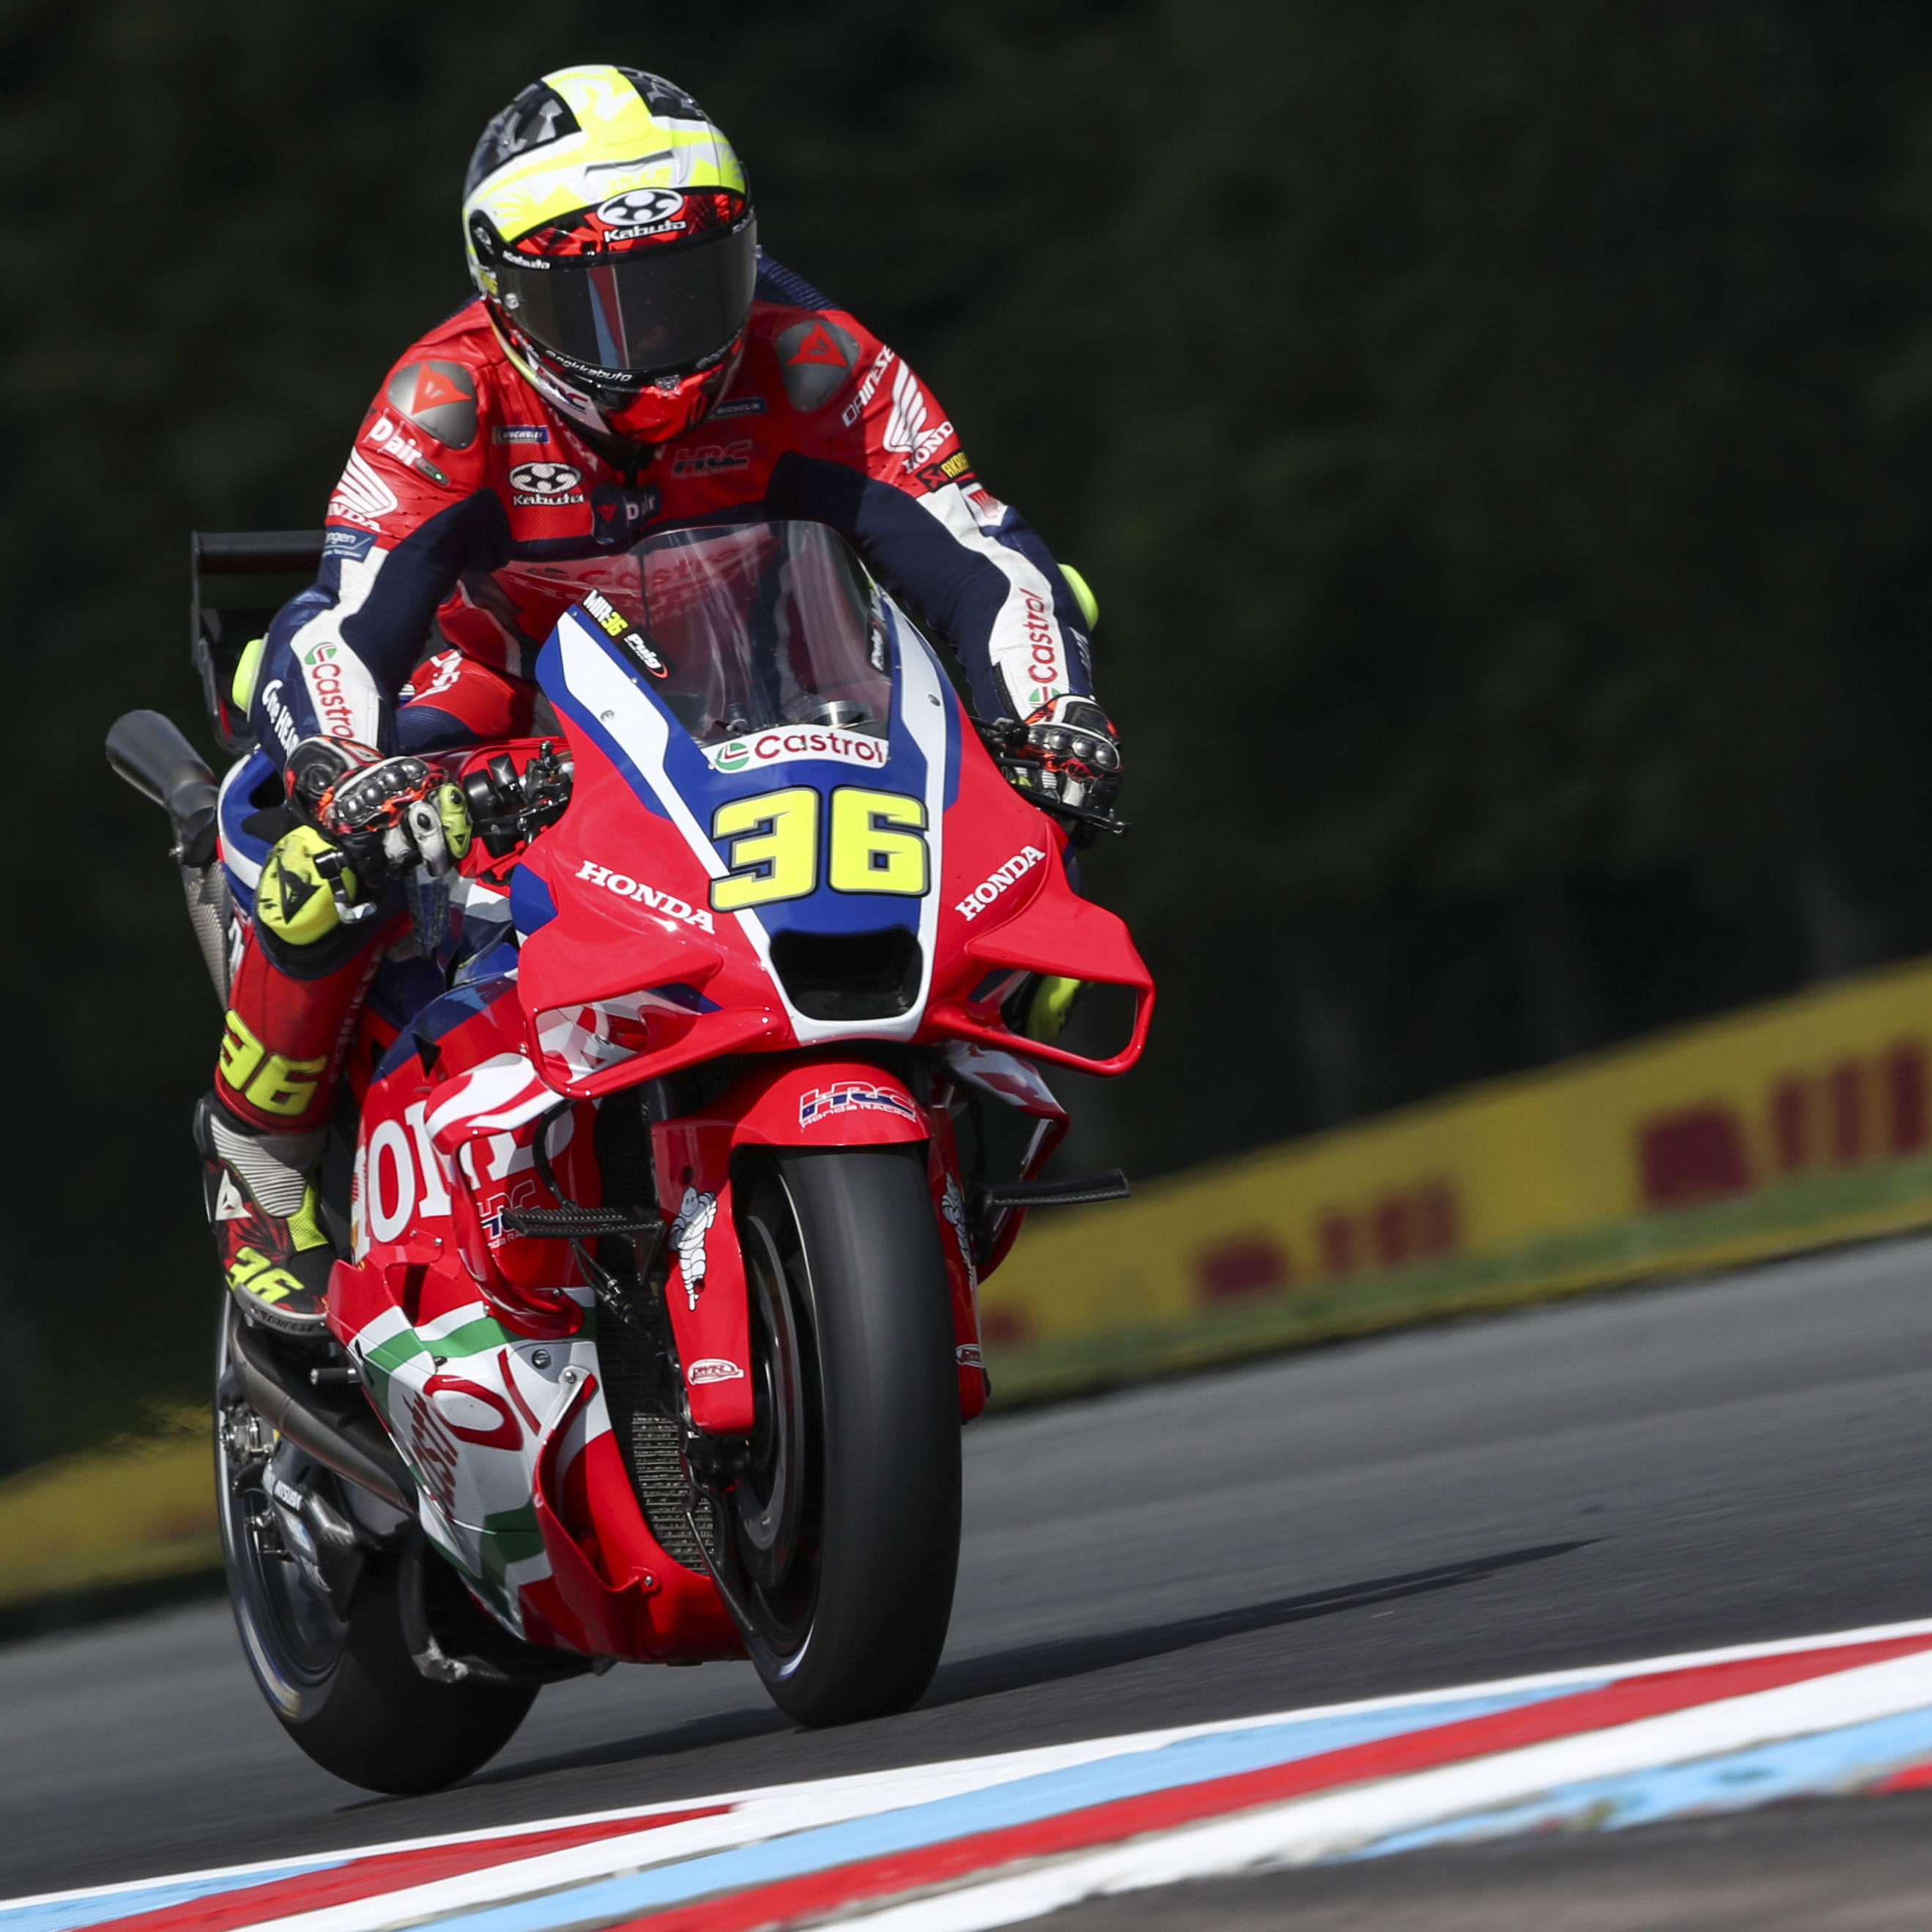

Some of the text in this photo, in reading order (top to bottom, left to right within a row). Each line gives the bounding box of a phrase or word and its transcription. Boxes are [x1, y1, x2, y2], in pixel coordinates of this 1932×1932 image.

[603, 220, 686, 243] Kabuto
[841, 345, 895, 427] DAINESE
[902, 420, 954, 475] HOND
[327, 502, 382, 532] NDA
[513, 493, 584, 506] Kabuto
[625, 633, 662, 669] Puig
[1019, 588, 1058, 684] Castrol
[311, 664, 355, 739] Castro
[754, 733, 884, 763] Castrol
[710, 786, 930, 913] 36
[575, 860, 716, 935] HONDA
[954, 844, 1046, 921] HONDA
[219, 1008, 327, 1116] 36
[799, 1081, 915, 1123] HRC
[226, 1246, 305, 1304] 36
